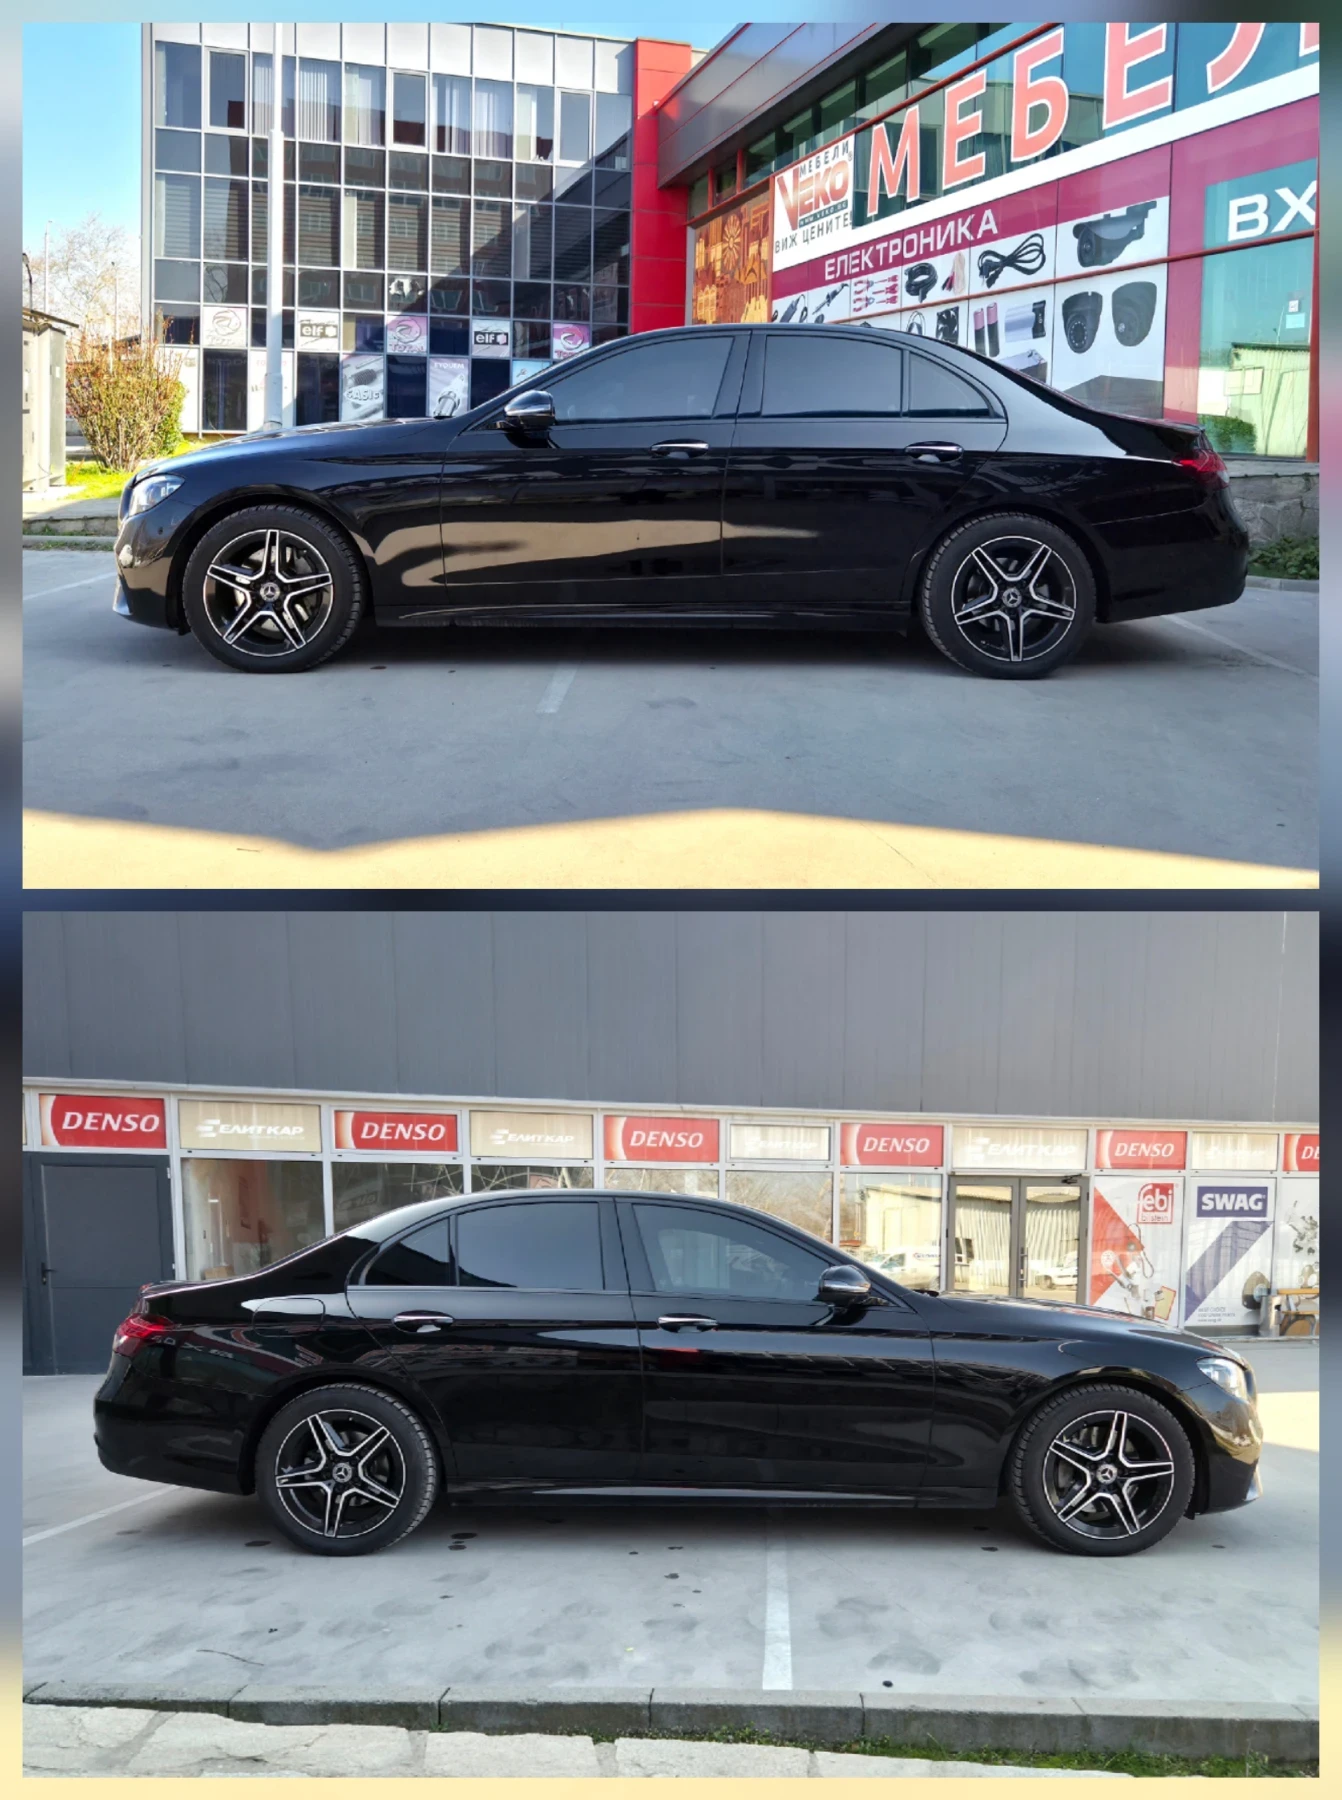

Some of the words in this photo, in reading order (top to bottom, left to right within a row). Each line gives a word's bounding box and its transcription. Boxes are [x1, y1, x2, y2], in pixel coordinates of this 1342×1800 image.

[799, 141, 849, 177] МЕБЕЛИ
[777, 160, 849, 231] VEKO
[775, 233, 798, 254] ВИЖ
[802, 211, 852, 245] ЦЕНИТЕ!
[824, 208, 998, 281] ЕЛЕКТРОНИКА
[302, 325, 324, 336] elf
[475, 332, 495, 343] elf
[61, 1111, 160, 1132] DENSO
[360, 1122, 446, 1141] DENSO
[629, 1130, 704, 1148] DENSO
[863, 1136, 930, 1153] DENSO
[1114, 1142, 1175, 1157] DENSO
[1138, 1184, 1173, 1211] febi
[1201, 1193, 1263, 1211] SWAG
